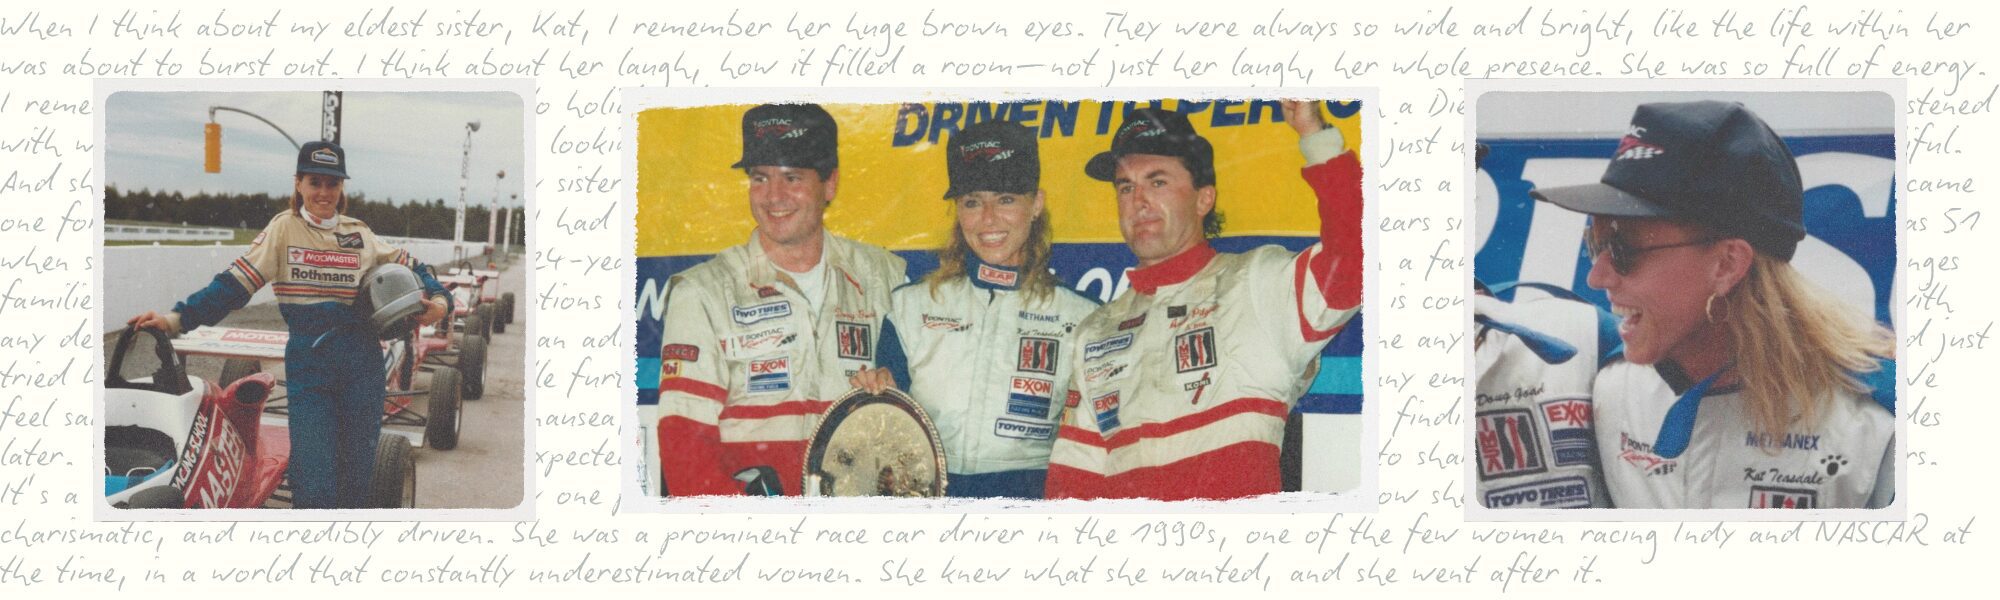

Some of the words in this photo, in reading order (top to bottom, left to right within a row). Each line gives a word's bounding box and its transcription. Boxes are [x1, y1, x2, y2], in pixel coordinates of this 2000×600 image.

[0, 11, 72, 41] When
[88, 13, 99, 35] I
[112, 8, 183, 41] think
[196, 9, 281, 38] about
[290, 21, 330, 43] my
[343, 5, 428, 38] eldest
[436, 8, 512, 46] sister,
[531, 8, 589, 46] Kat,
[608, 13, 619, 35] I
[632, 8, 772, 38] remember
[786, 11, 831, 41] her
[845, 11, 907, 58] huge
[922, 11, 1008, 37] brown
[1024, 20, 1084, 42] eyes.
[1103, 11, 1162, 43] They
[1175, 21, 1239, 38] were
[1252, 8, 1338, 43] always
[1353, 22, 1378, 37] so
[1394, 6, 1459, 37] wide
[1472, 6, 1533, 37] and
[1540, 8, 1633, 58] bright,
[1653, 7, 1699, 39] like
[1712, 8, 1756, 41] the
[1770, 4, 1814, 48] life
[1827, 8, 1909, 41] within
[1926, 11, 1971, 41] her
[0, 60, 47, 76] was
[62, 47, 148, 77] about
[154, 47, 183, 77] to
[198, 47, 275, 77] burst
[283, 47, 338, 77] out.
[356, 53, 367, 74] I
[380, 47, 451, 79] think
[464, 47, 550, 77] about
[559, 50, 604, 80] her
[617, 46, 700, 88] laugh,
[720, 50, 779, 80] how
[791, 47, 816, 77] it
[820, 43, 905, 87] filled
[912, 63, 926, 76] a
[1104, 43, 1164, 88] just
[1173, 50, 1218, 80] her
[1231, 47, 1314, 88] laugh,
[1334, 50, 1379, 80] her
[1392, 47, 1472, 80] whole
[1482, 60, 1602, 79] presence.
[1620, 50, 1667, 79] She
[1681, 60, 1728, 76] was
[1743, 61, 1769, 76] so
[1781, 43, 1841, 79] full
[1847, 43, 1886, 79] of
[1891, 60, 1986, 97] energy.
[0, 91, 11, 113] I
[0, 125, 63, 158] with
[1379, 121, 1442, 169] just
[0, 161, 63, 195] And
[0, 216, 46, 232] one
[556, 200, 617, 236] had
[1943, 207, 1981, 234] 51
[0, 245, 68, 275] when
[291, 267, 356, 283] Rothmans
[757, 304, 788, 315] TIRES
[1018, 310, 1061, 323] METHANEX
[0, 333, 46, 355] any
[745, 327, 784, 340] PONTIAC
[1930, 316, 1994, 364] just
[0, 356, 75, 389] tried
[751, 359, 787, 374] EXXON
[1013, 378, 1052, 395] EXXON
[1476, 392, 1511, 407] Doug
[0, 394, 58, 432] feel
[997, 421, 1026, 432] TOYO
[1546, 400, 1592, 428] EXXO
[0, 436, 73, 467] later.
[1746, 430, 1820, 450] METANEX
[0, 473, 49, 506] It's
[64, 492, 78, 505] a
[1744, 467, 1767, 481] Kat
[1769, 468, 1824, 485] Teasdale
[1490, 489, 1538, 508] TOYO
[1538, 484, 1585, 500] TIRES
[0, 516, 164, 553] charismatic,
[183, 521, 238, 544] and
[249, 521, 385, 549] incredibly
[397, 521, 494, 545] driven.
[511, 518, 558, 548] She
[573, 528, 619, 544] was
[635, 531, 649, 544] a
[659, 515, 807, 556] prominent
[815, 528, 869, 545] race
[882, 529, 926, 544] car
[939, 512, 1025, 545] driver
[1038, 516, 1059, 544] in
[1074, 516, 1118, 548] the
[1130, 520, 1226, 553] 1990s,
[1246, 528, 1291, 544] one
[1305, 512, 1344, 555] of
[1349, 515, 1393, 548] the
[1402, 511, 1460, 555] few
[1472, 528, 1564, 545] women
[1580, 529, 1657, 565] racing
[1673, 521, 1736, 549] Indy
[1749, 521, 1804, 544] and
[1815, 512, 1929, 547] NASCAR
[1943, 515, 1976, 545] at
[0, 554, 43, 587] the
[56, 554, 126, 592] time,
[144, 555, 165, 583] in
[182, 569, 196, 583] a
[211, 552, 303, 584] world
[308, 554, 372, 587] that
[380, 553, 515, 589] constantly
[529, 551, 751, 584] underestimated
[757, 567, 862, 584] women.
[879, 558, 927, 587] She
[940, 555, 1012, 584] knew
[1023, 554, 1098, 587] what
[1106, 557, 1148, 587] she
[1161, 551, 1271, 592] wanted,
[1290, 552, 1350, 583] and
[1356, 557, 1398, 587] she
[1412, 554, 1482, 584] went
[1490, 550, 1560, 594] after
[1573, 554, 1602, 584] it.
